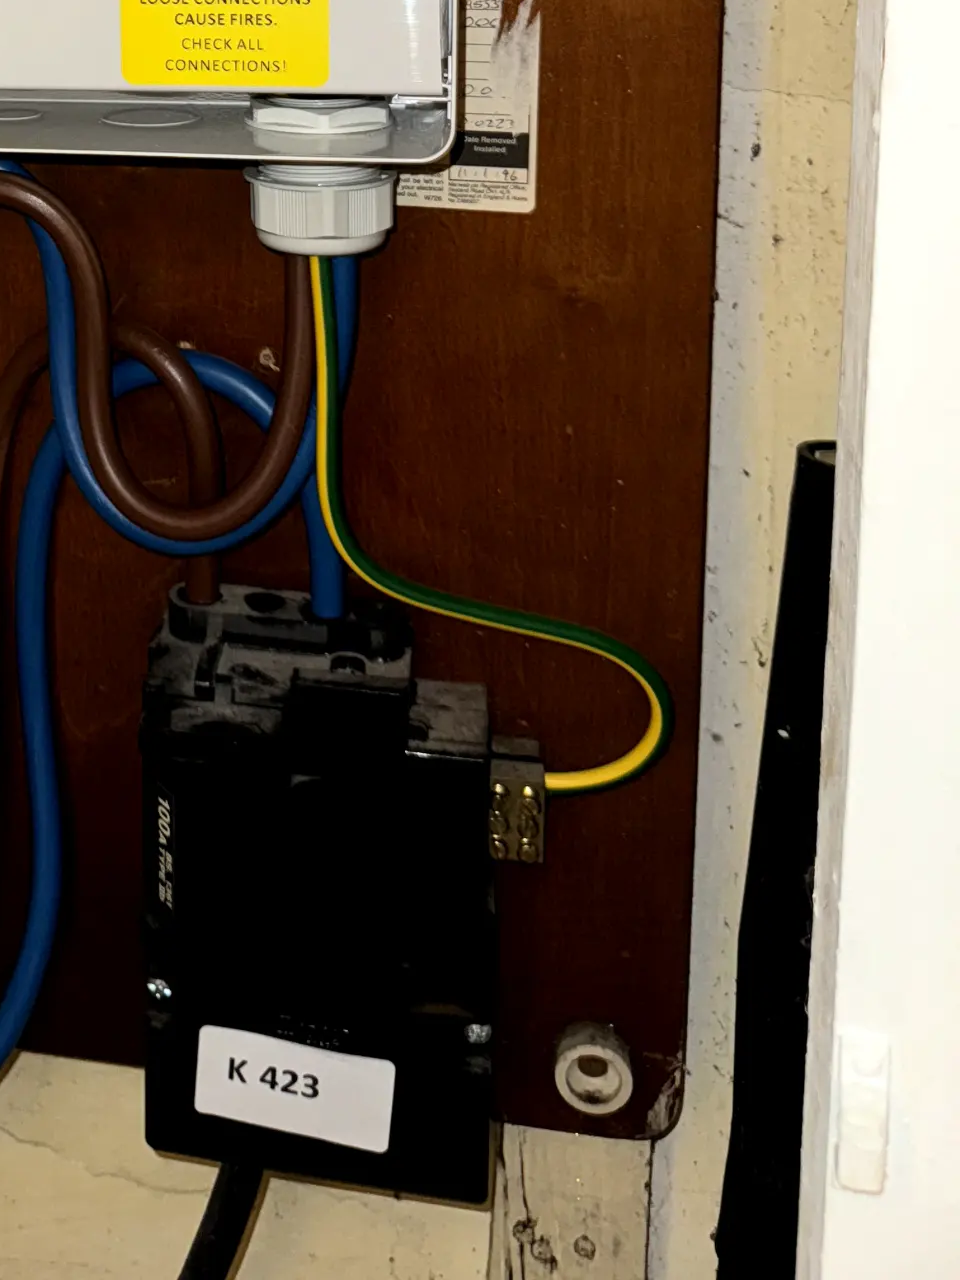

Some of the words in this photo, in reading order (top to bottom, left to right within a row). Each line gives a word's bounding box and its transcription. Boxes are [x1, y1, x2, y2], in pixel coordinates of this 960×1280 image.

[174, 13, 226, 26] CAUSE
[230, 13, 278, 26] FIRES.
[182, 38, 233, 50] CHECK
[237, 38, 264, 51] ALL
[165, 59, 288, 73] CONNECTIONS!
[481, 136, 517, 145] Removed
[474, 145, 506, 154] Installed
[157, 794, 171, 846] 100A
[158, 846, 166, 882] TYPE
[227, 1057, 248, 1084] K
[259, 1069, 320, 1100] 423
